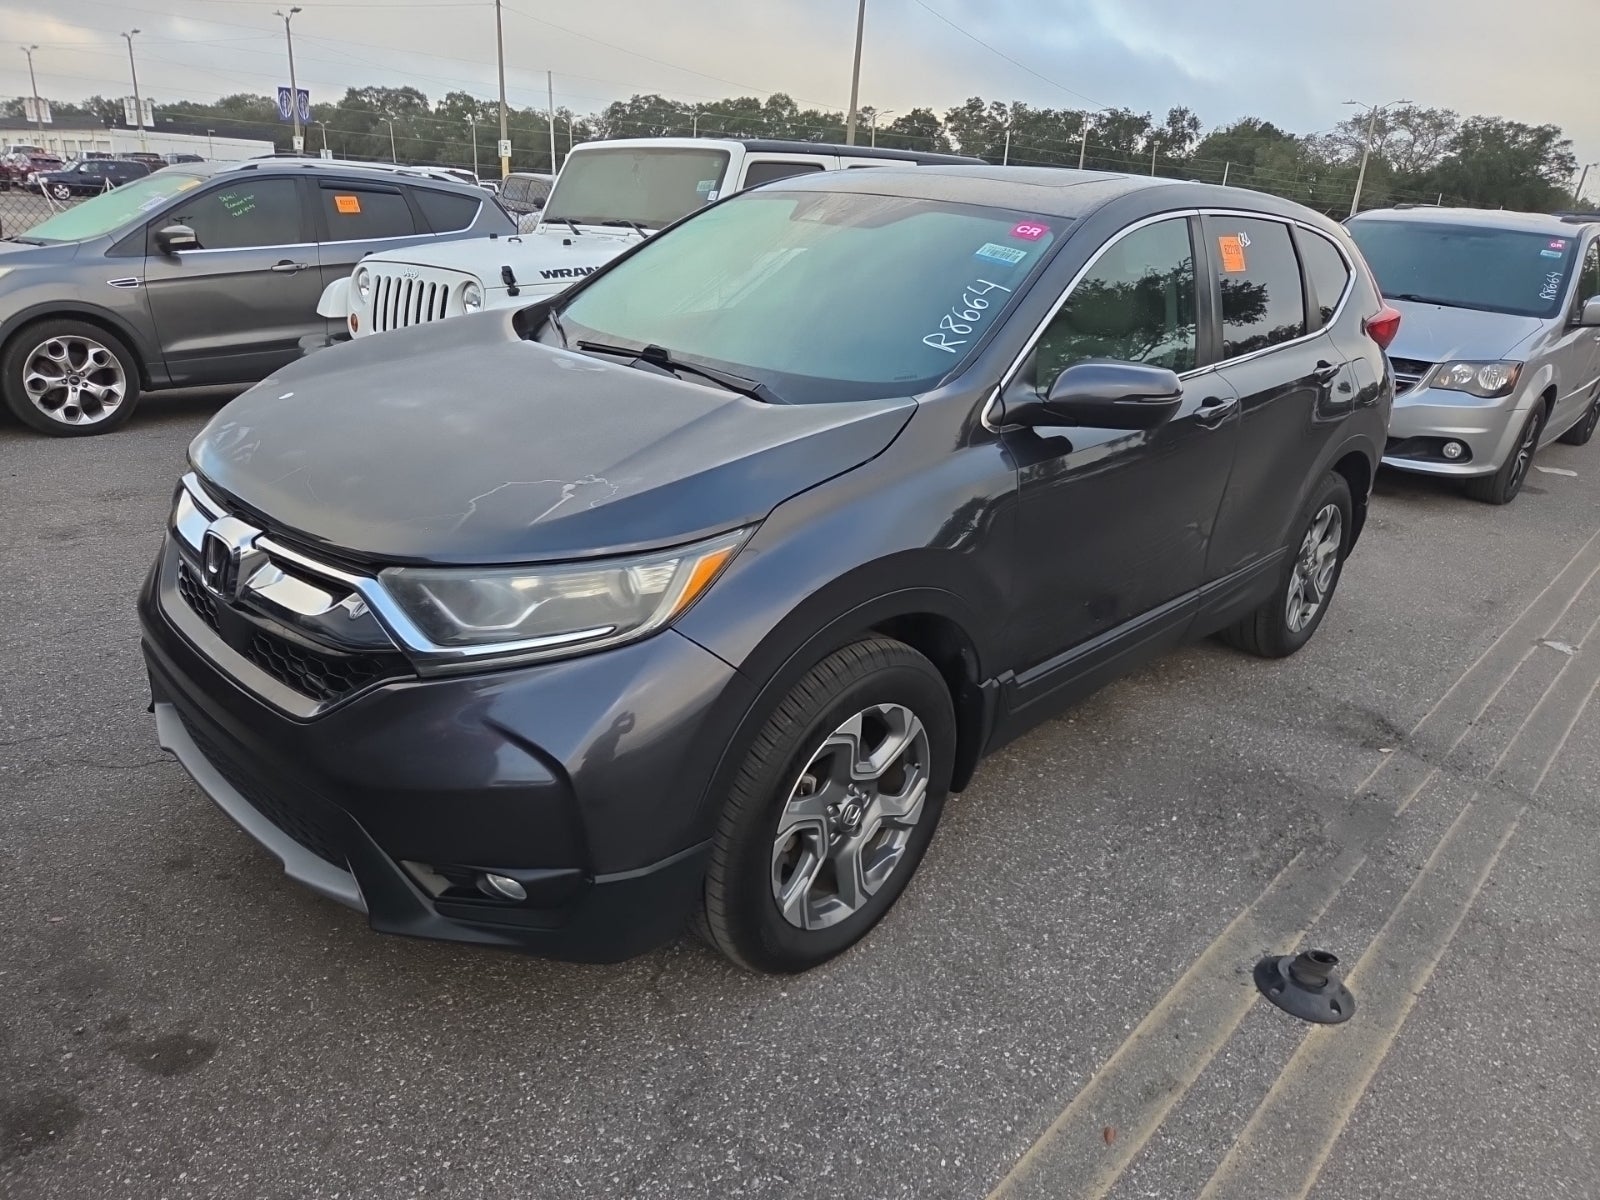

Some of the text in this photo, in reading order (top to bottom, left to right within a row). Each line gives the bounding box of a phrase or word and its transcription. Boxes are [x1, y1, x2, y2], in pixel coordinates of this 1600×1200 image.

[1016, 225, 1042, 236] CR
[1538, 271, 1563, 301] R8664
[922, 278, 1012, 354] R8664
